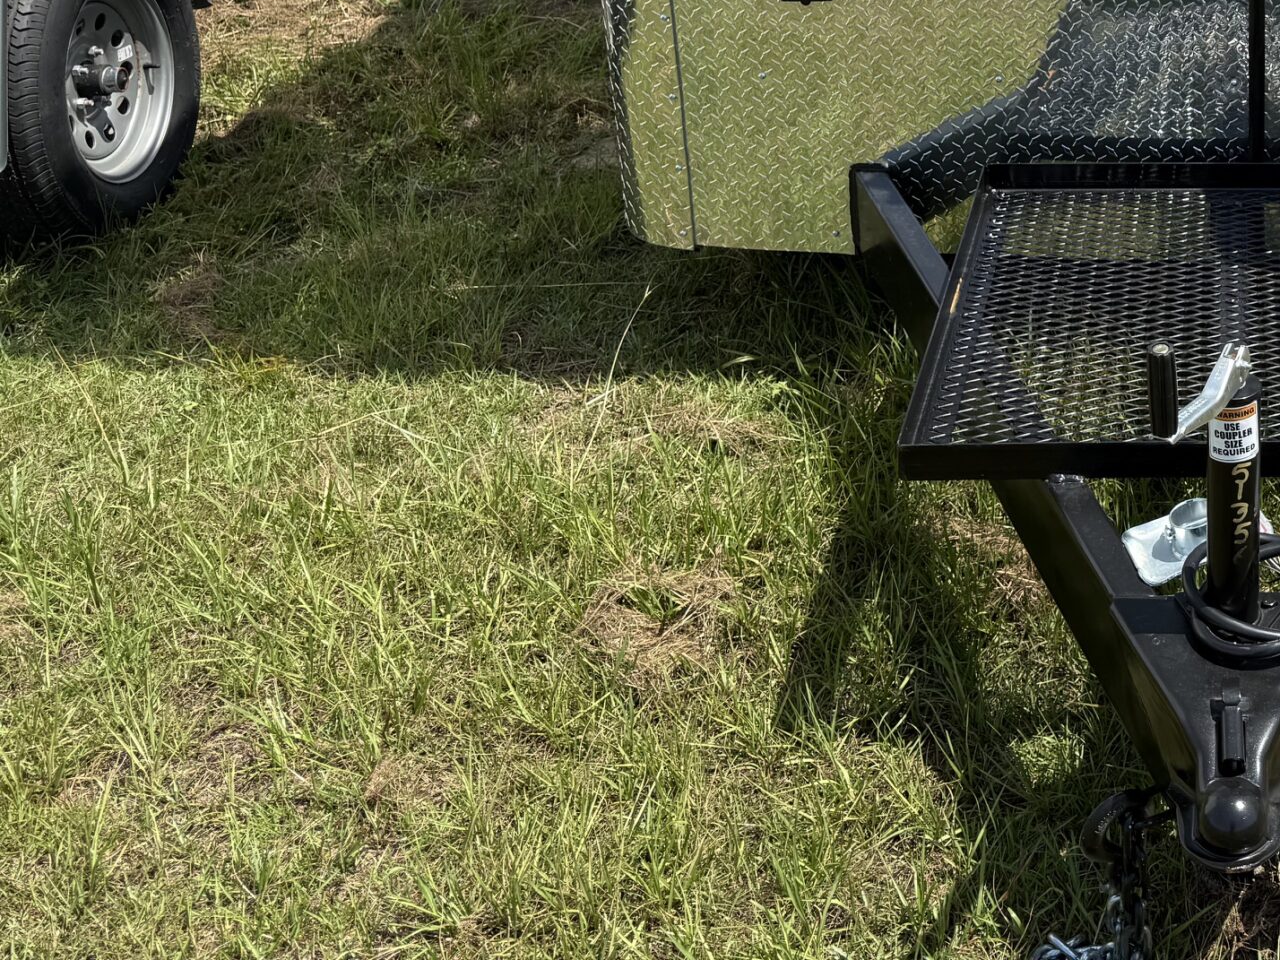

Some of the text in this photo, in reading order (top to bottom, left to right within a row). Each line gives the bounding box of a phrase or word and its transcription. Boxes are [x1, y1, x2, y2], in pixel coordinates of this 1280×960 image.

[1224, 423, 1240, 431] USE
[1214, 427, 1253, 440] COUPLER
[1213, 443, 1256, 456] REQUIRED
[1224, 440, 1243, 449] SIZE
